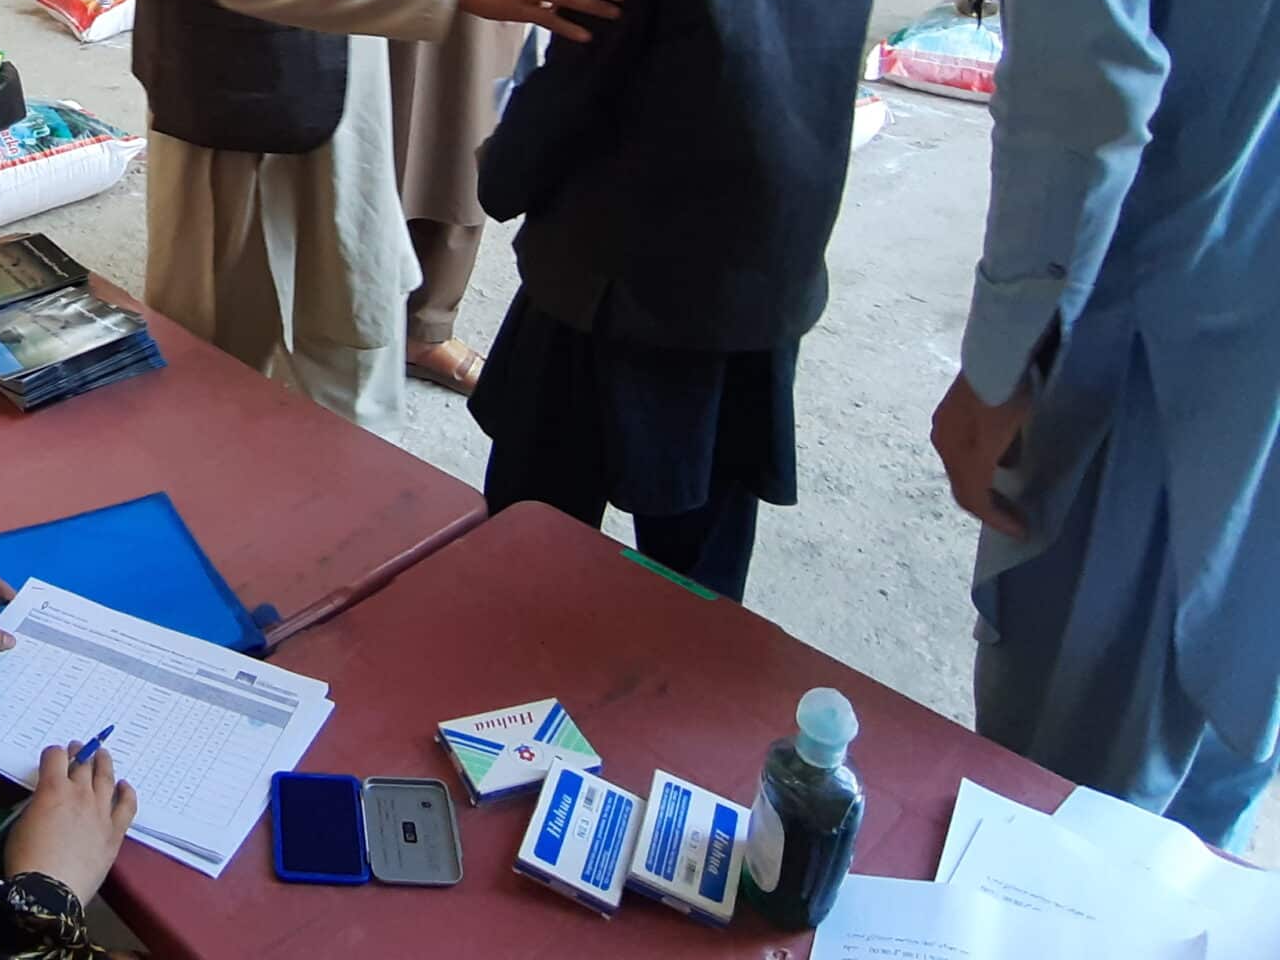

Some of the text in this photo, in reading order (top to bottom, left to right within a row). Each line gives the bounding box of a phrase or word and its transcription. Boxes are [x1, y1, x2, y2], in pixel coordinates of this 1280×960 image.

[474, 711, 534, 732] Huhua
[545, 793, 574, 839] Huhua
[707, 828, 730, 875] Huhua
